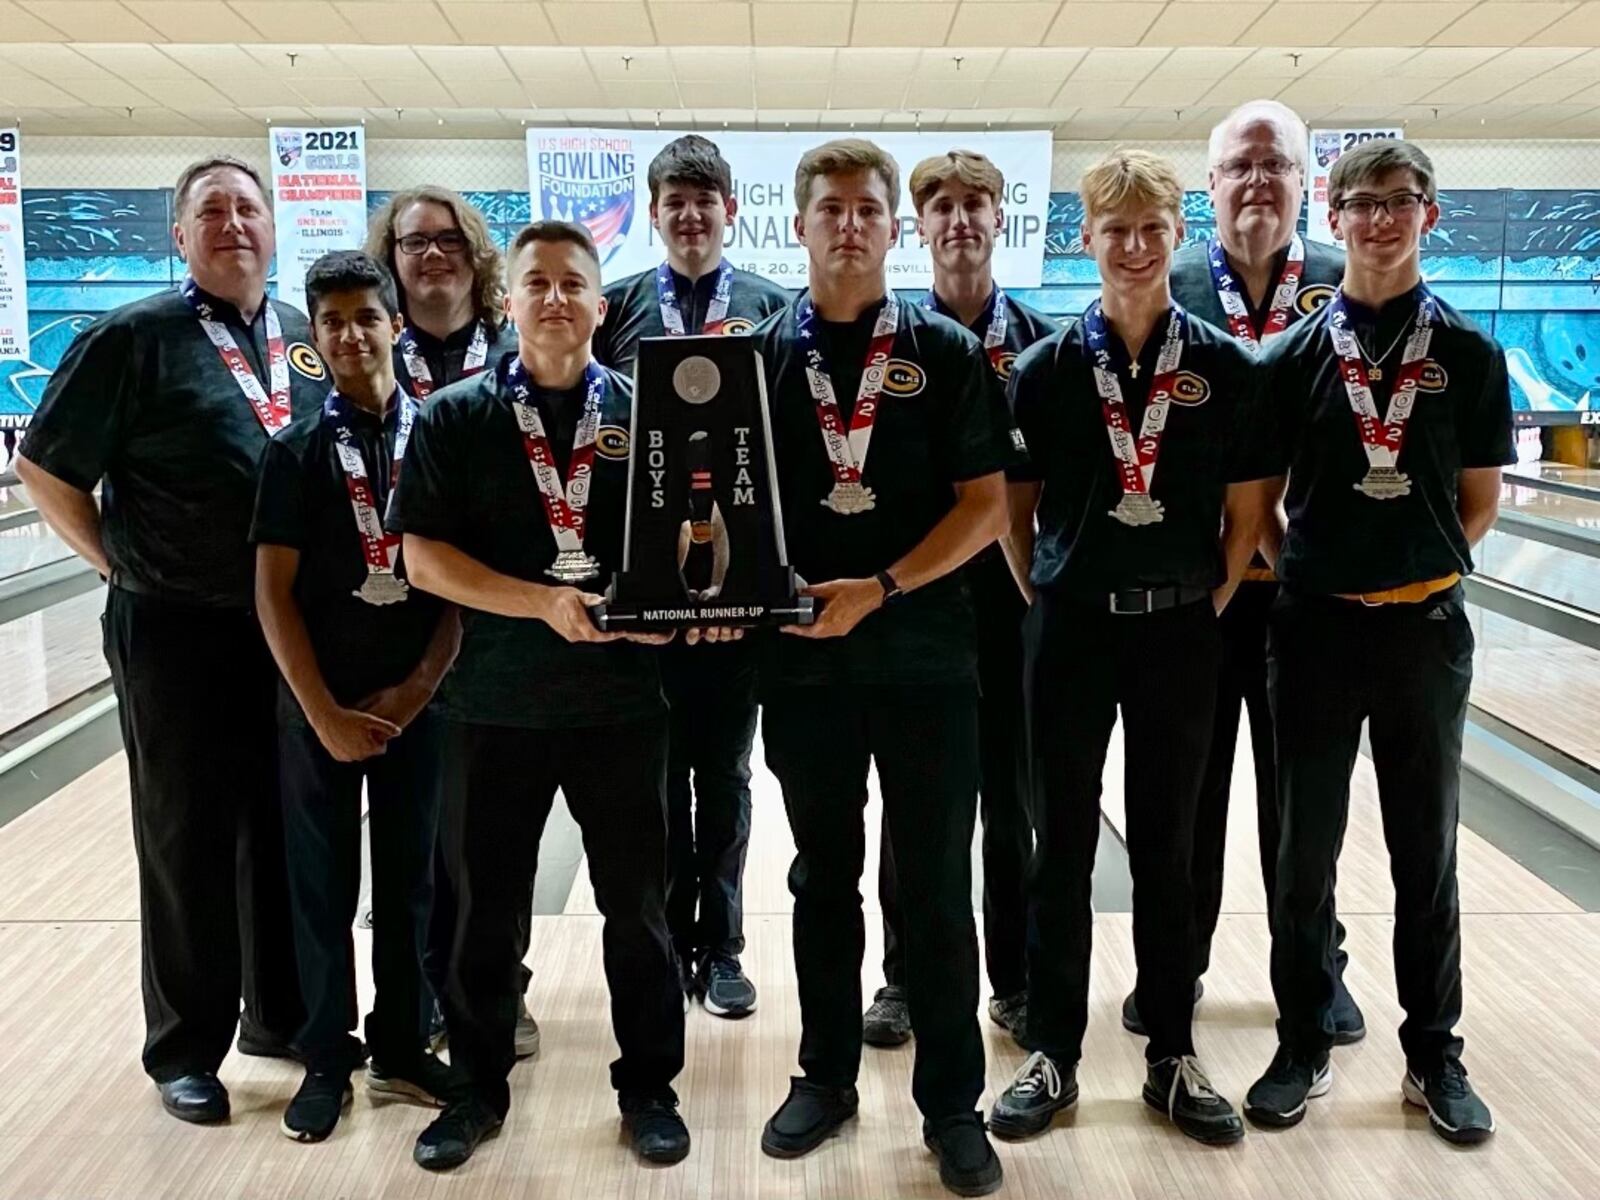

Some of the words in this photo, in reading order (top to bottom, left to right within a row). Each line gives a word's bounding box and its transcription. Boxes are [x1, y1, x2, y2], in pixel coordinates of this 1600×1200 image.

[305, 132, 358, 150] 2021
[560, 137, 585, 150] HIGH
[590, 137, 632, 151] SCHOOL
[305, 155, 360, 170] GIRLS
[539, 152, 634, 180] BOWLING
[278, 174, 362, 187] NATIONAL
[541, 176, 634, 197] FOUNDATION
[278, 189, 362, 201] CHAMPIONS
[857, 351, 889, 417] 2022
[1384, 379, 1415, 441] 2022
[1140, 390, 1169, 455] 2022
[648, 430, 666, 508] BOYS
[733, 427, 755, 505] TEAM
[569, 463, 590, 530] 2022
[643, 608, 698, 621] NATIONAL
[700, 606, 764, 619] RUNNER-UP
